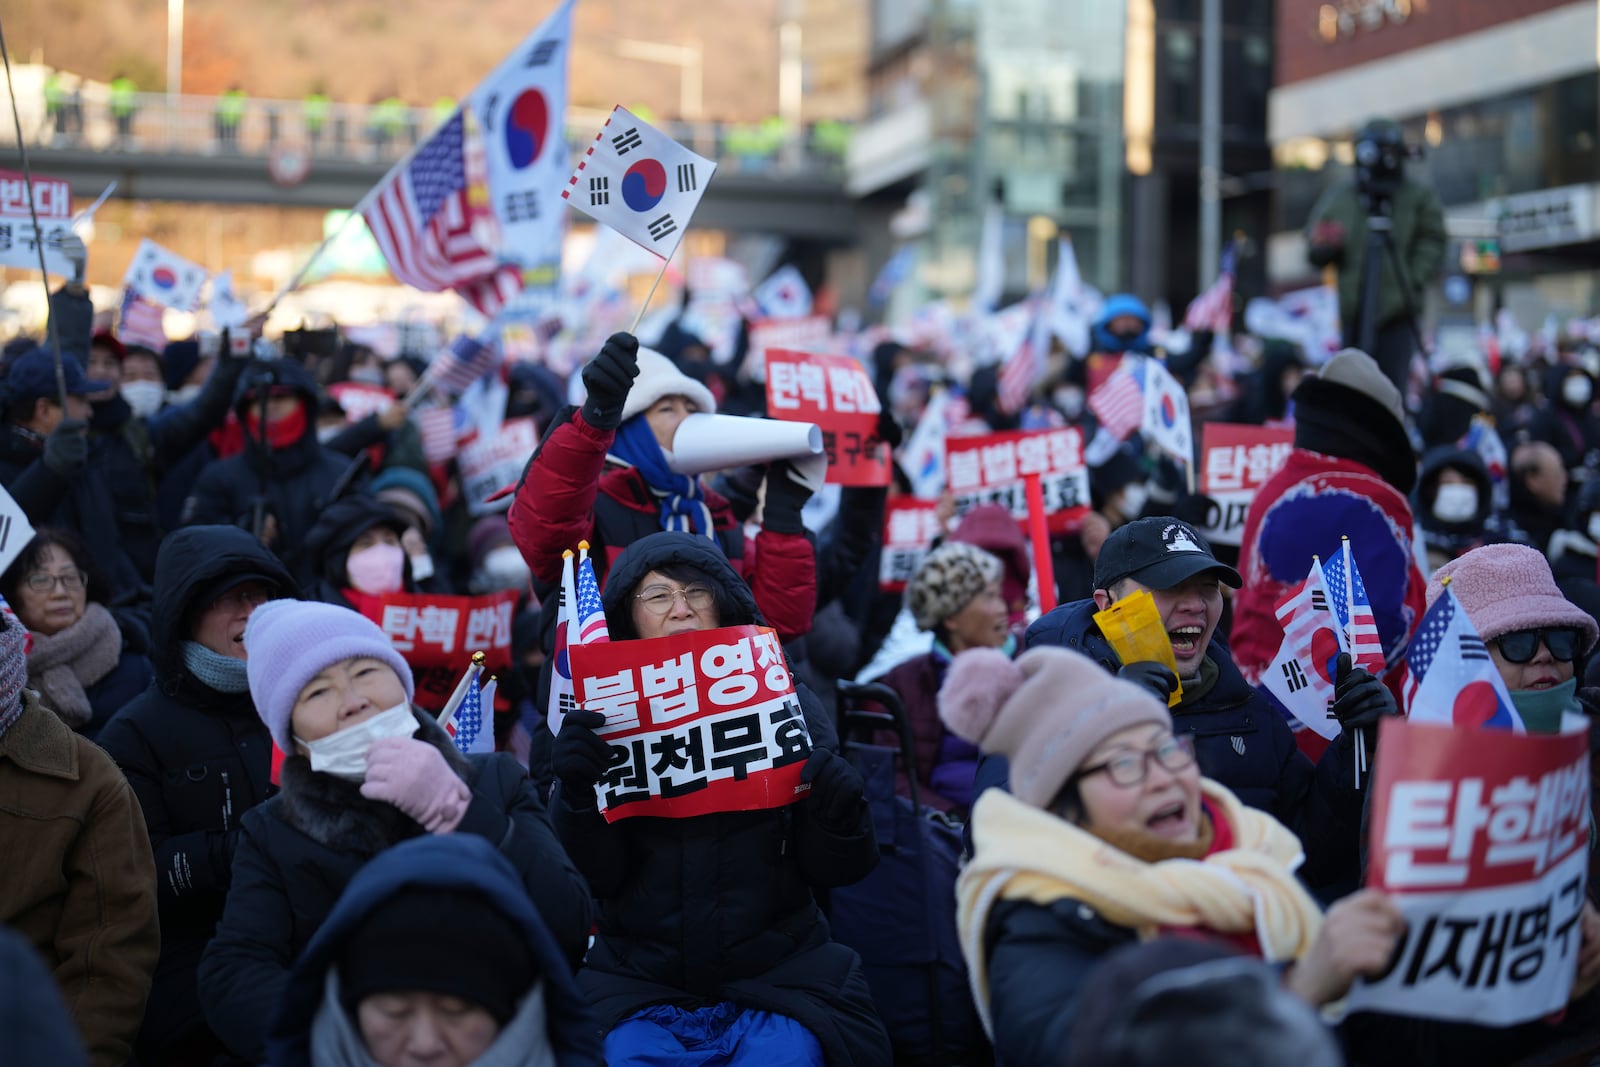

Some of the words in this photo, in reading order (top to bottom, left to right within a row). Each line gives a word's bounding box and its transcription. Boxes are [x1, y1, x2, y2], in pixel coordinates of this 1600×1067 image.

[769, 362, 827, 410] 탄핵
[382, 605, 458, 653] 탄핵
[577, 631, 791, 736] 불법영장
[599, 701, 814, 811] 원천무효
